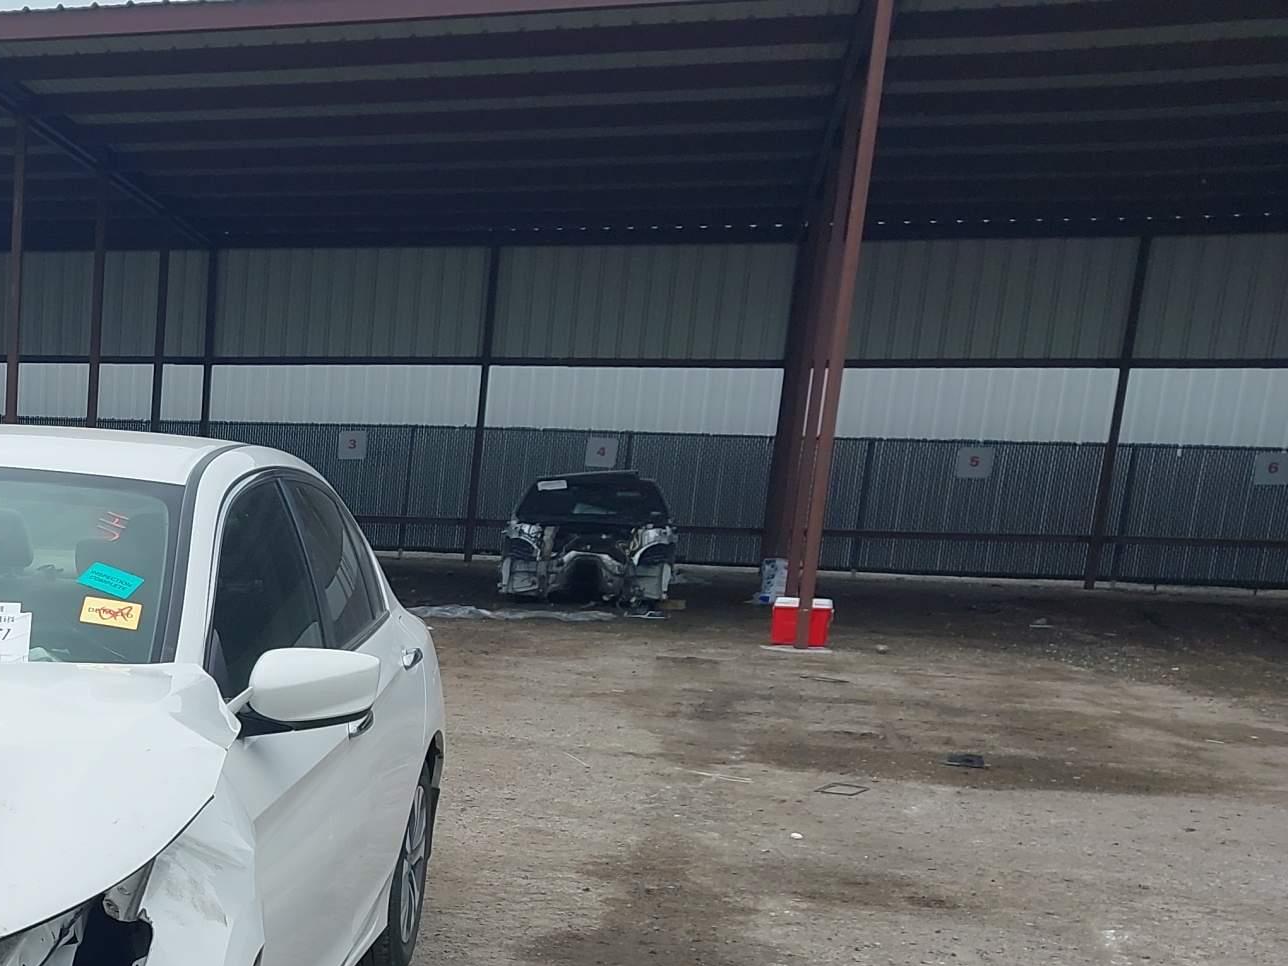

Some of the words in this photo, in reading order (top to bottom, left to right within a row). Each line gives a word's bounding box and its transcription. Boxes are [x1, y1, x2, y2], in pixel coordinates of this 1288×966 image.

[348, 439, 357, 449] 3
[596, 446, 606, 457] 4
[969, 455, 980, 467] 5
[1268, 462, 1279, 474] 6
[90, 569, 133, 588] INSPECTION
